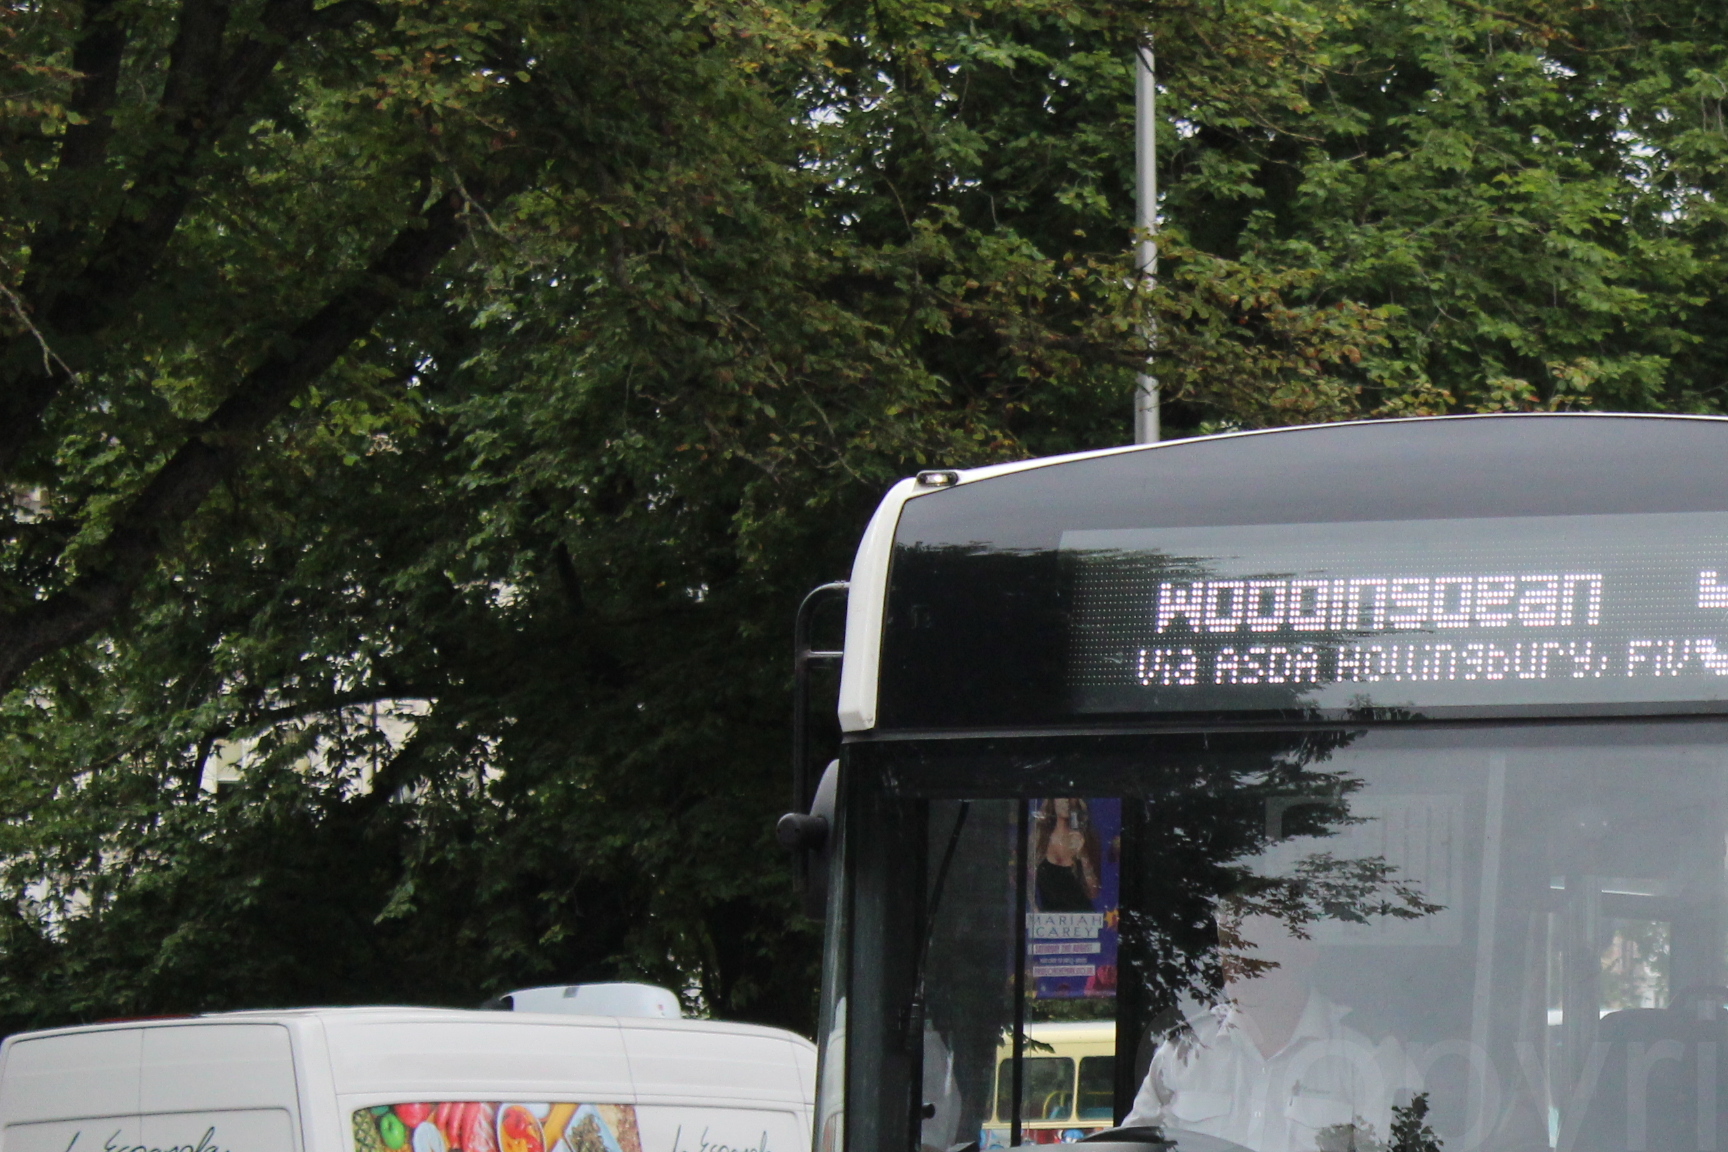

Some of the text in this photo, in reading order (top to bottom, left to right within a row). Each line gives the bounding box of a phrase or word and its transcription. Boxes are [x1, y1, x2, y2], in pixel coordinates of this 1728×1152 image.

[1213, 646, 1319, 685] ASDA
[1027, 915, 1103, 926] MARIAH
[1036, 926, 1094, 938] CAREY
